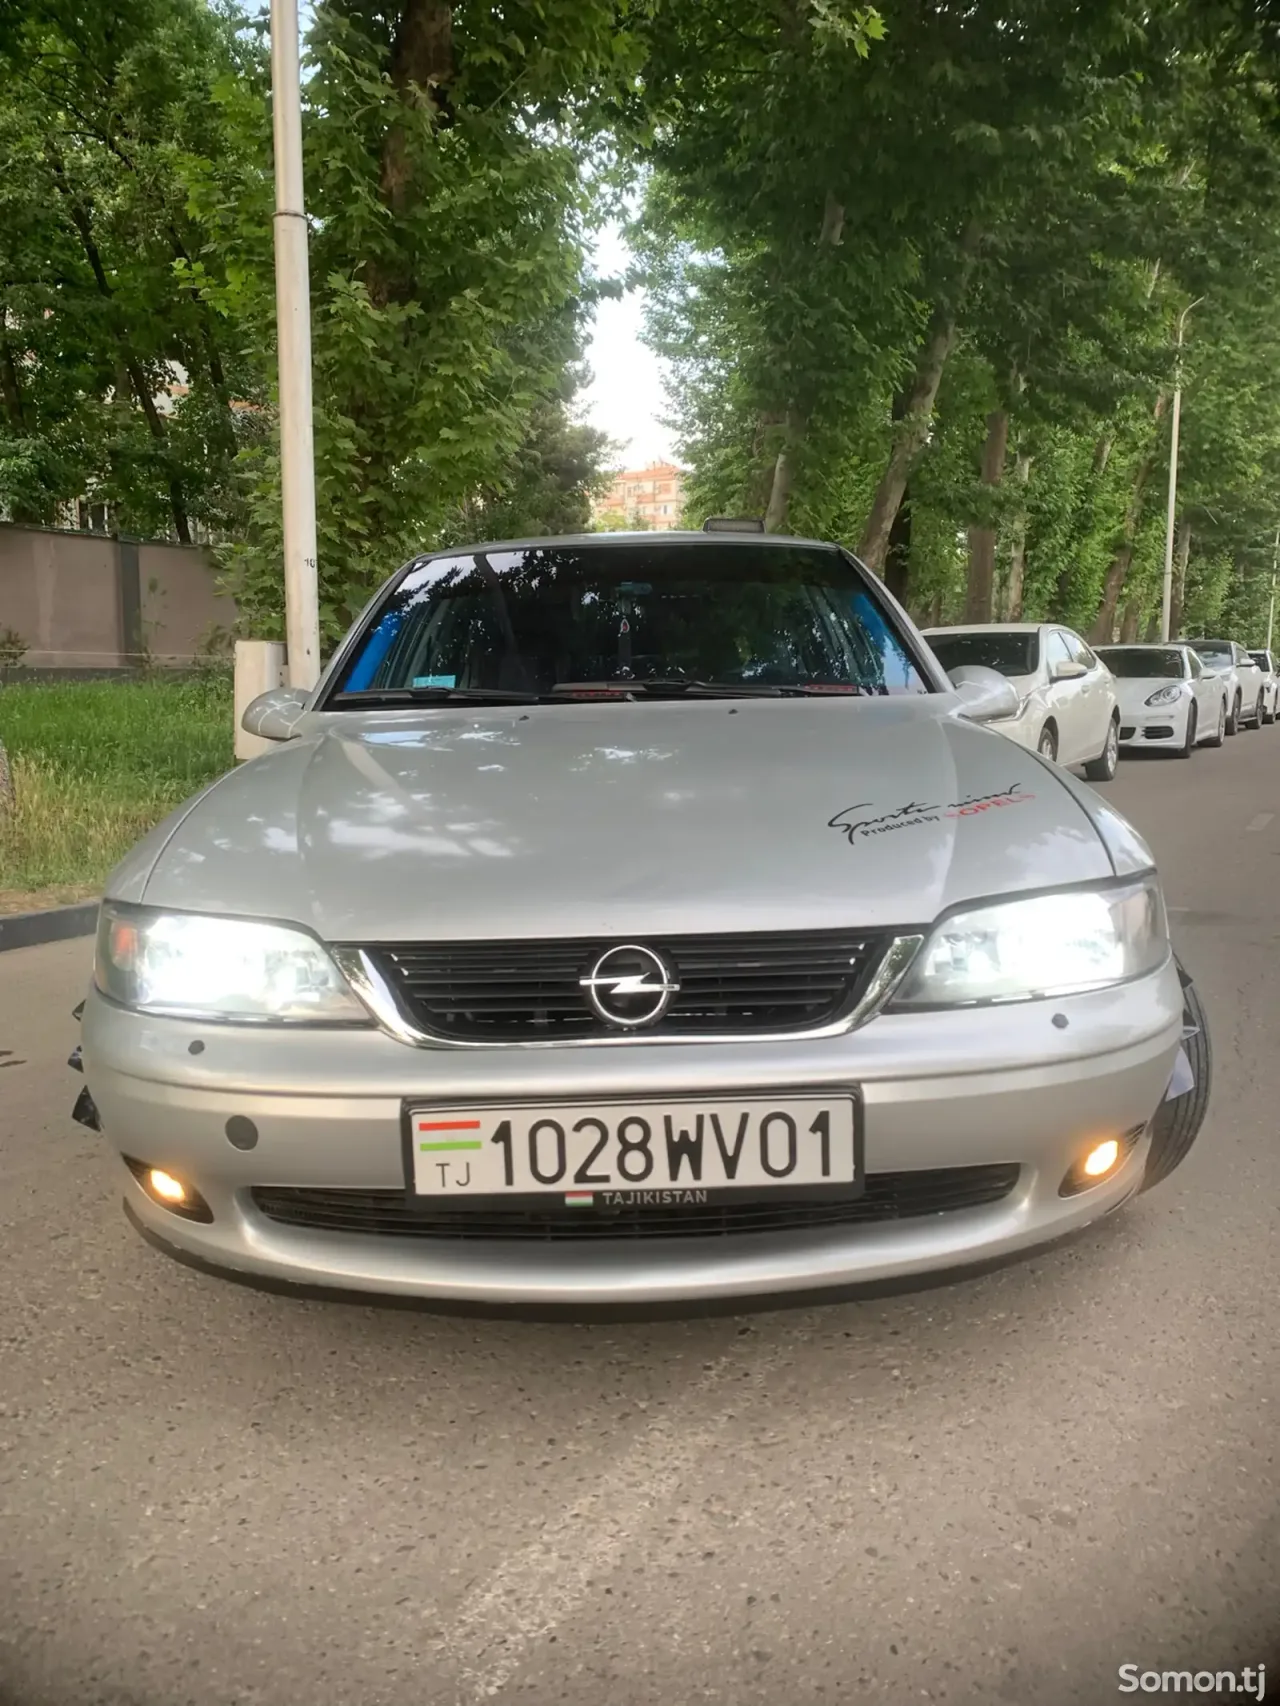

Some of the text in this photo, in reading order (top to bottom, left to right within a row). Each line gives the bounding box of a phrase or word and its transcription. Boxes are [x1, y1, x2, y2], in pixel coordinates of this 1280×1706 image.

[860, 817, 923, 837] Produced
[922, 815, 940, 823] by
[491, 1110, 830, 1187] 1028WV01
[435, 1162, 471, 1188] TJ
[602, 1190, 708, 1205] TAJIKISTAN
